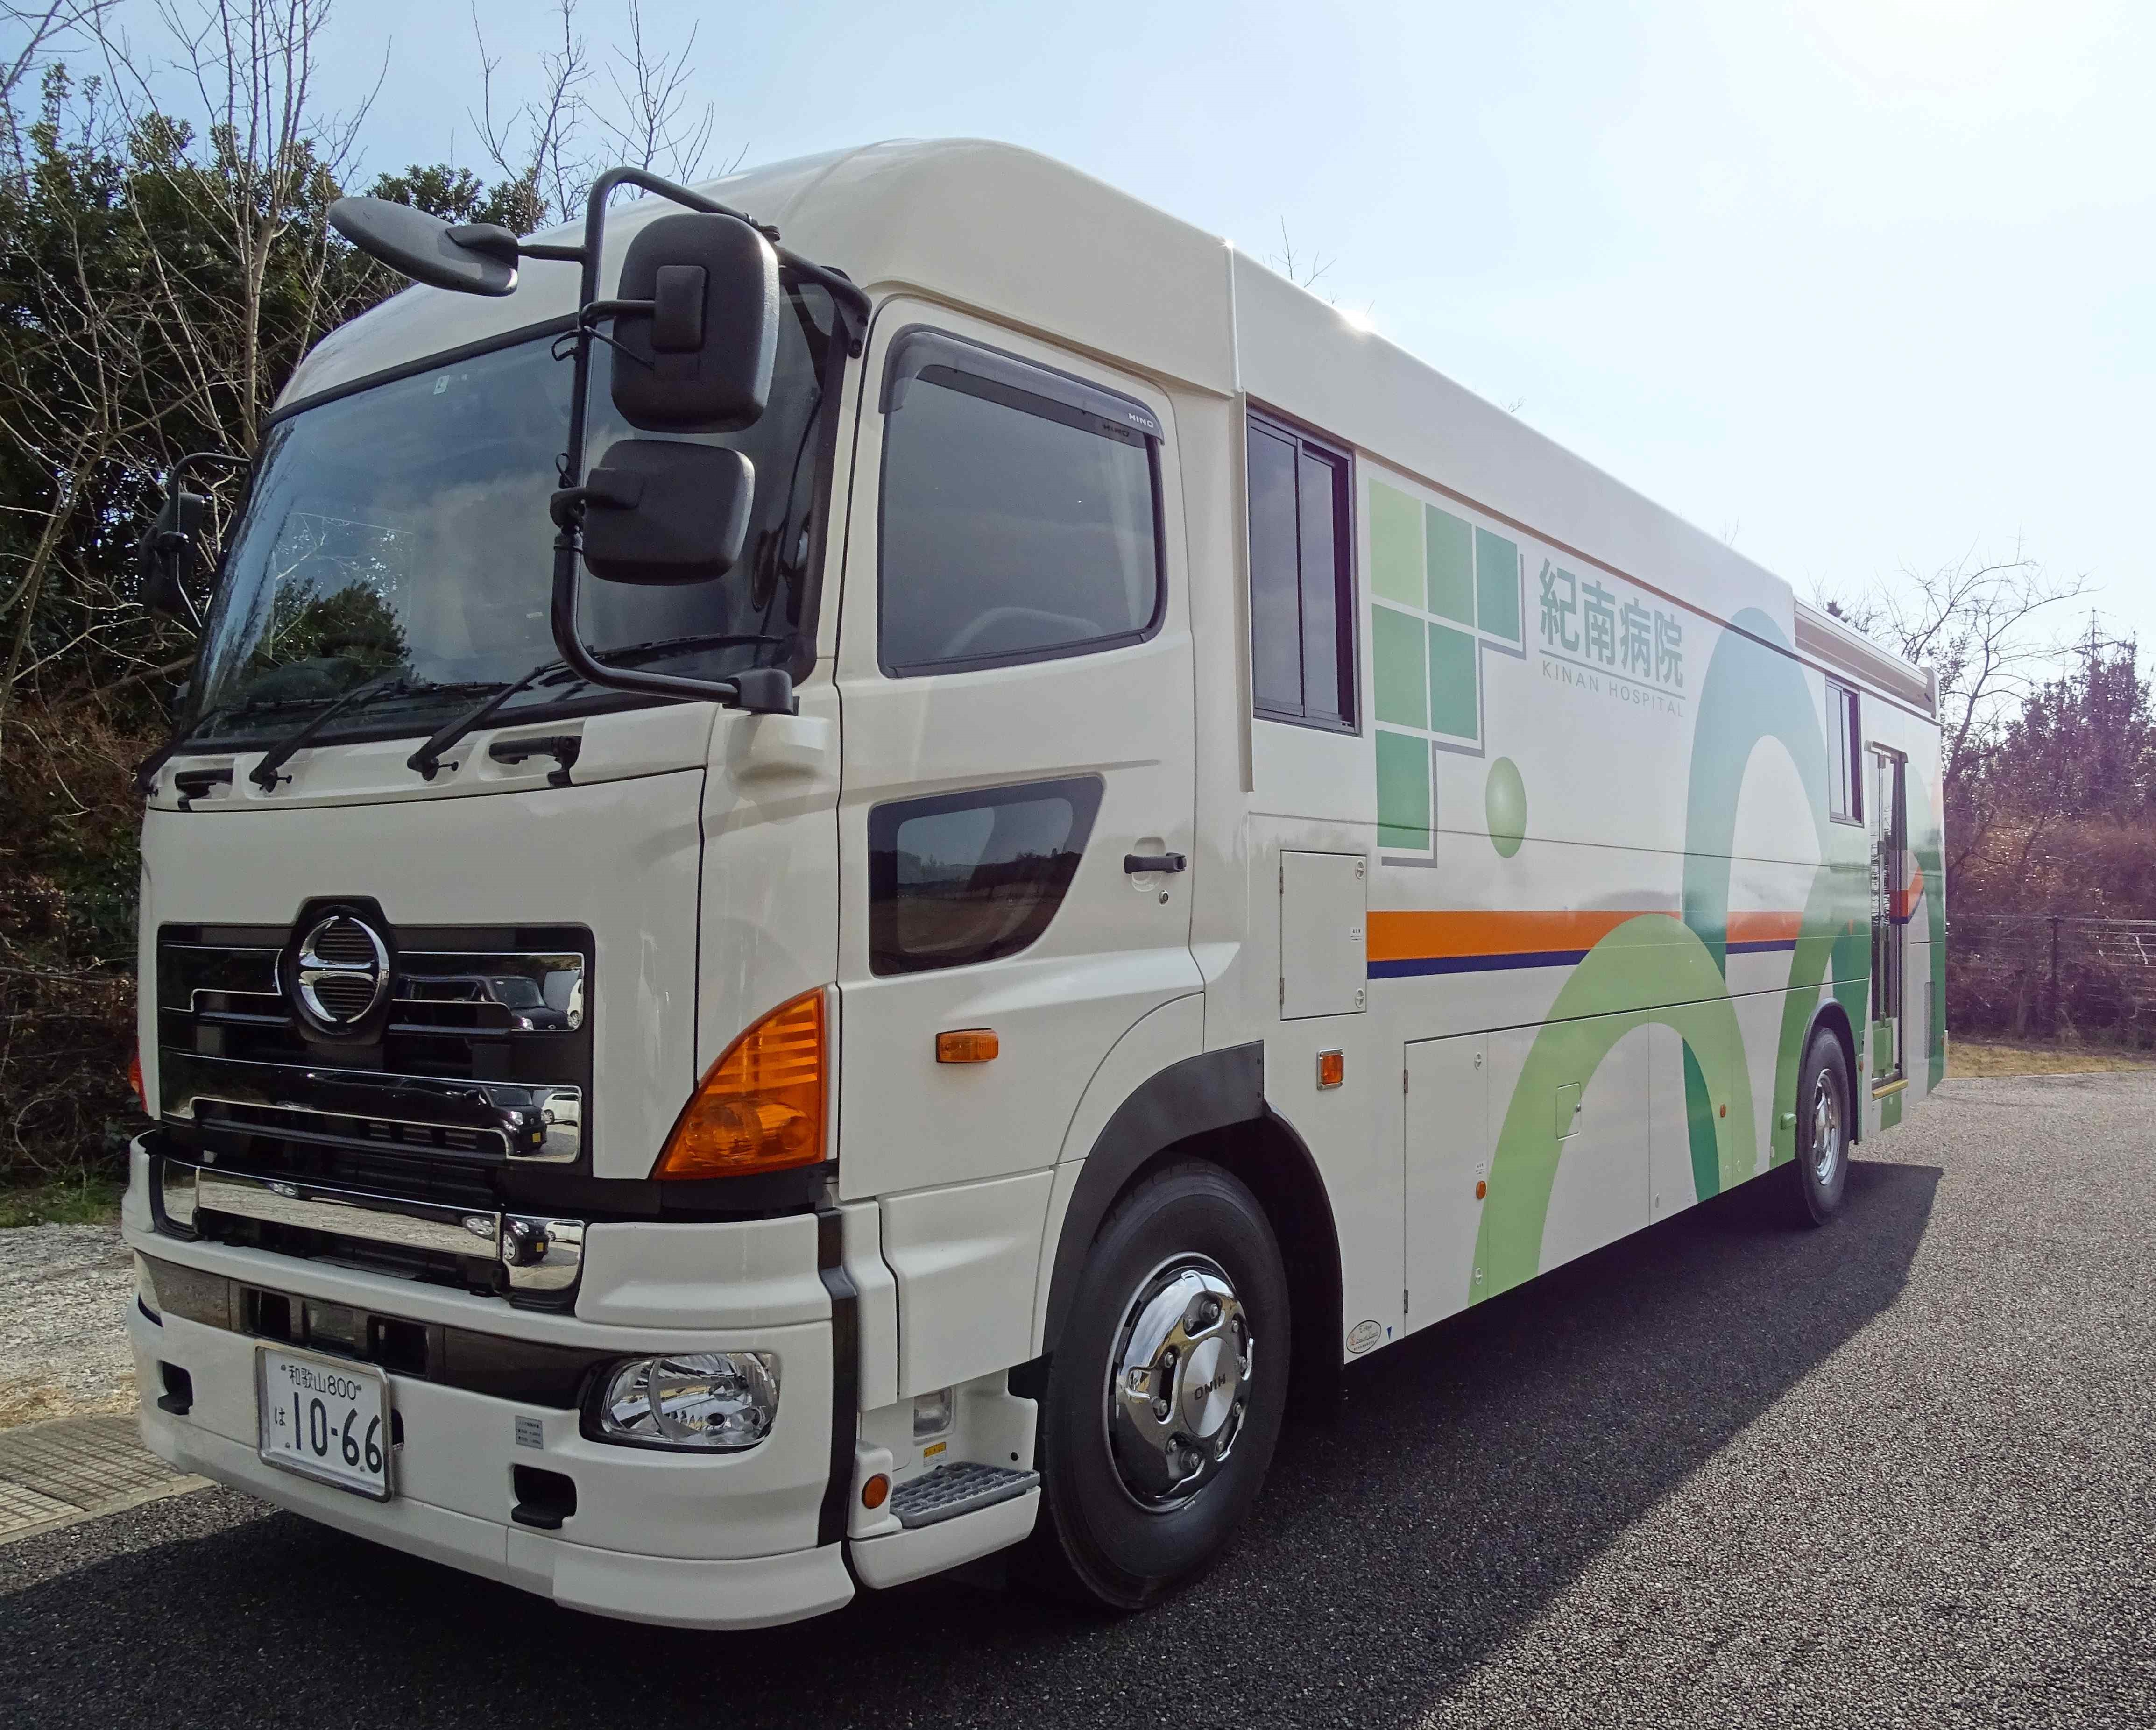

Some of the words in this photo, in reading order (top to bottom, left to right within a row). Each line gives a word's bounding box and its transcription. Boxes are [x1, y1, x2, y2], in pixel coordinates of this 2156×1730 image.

[1128, 413, 1154, 428] HINO
[1539, 558, 1683, 688] 紀南病院
[1542, 661, 1599, 692] KINAN
[1609, 684, 1684, 718] HOSPITAL
[1194, 1373, 1226, 1400] HINO
[275, 1406, 286, 1426] は
[294, 1391, 382, 1473] 10-66
